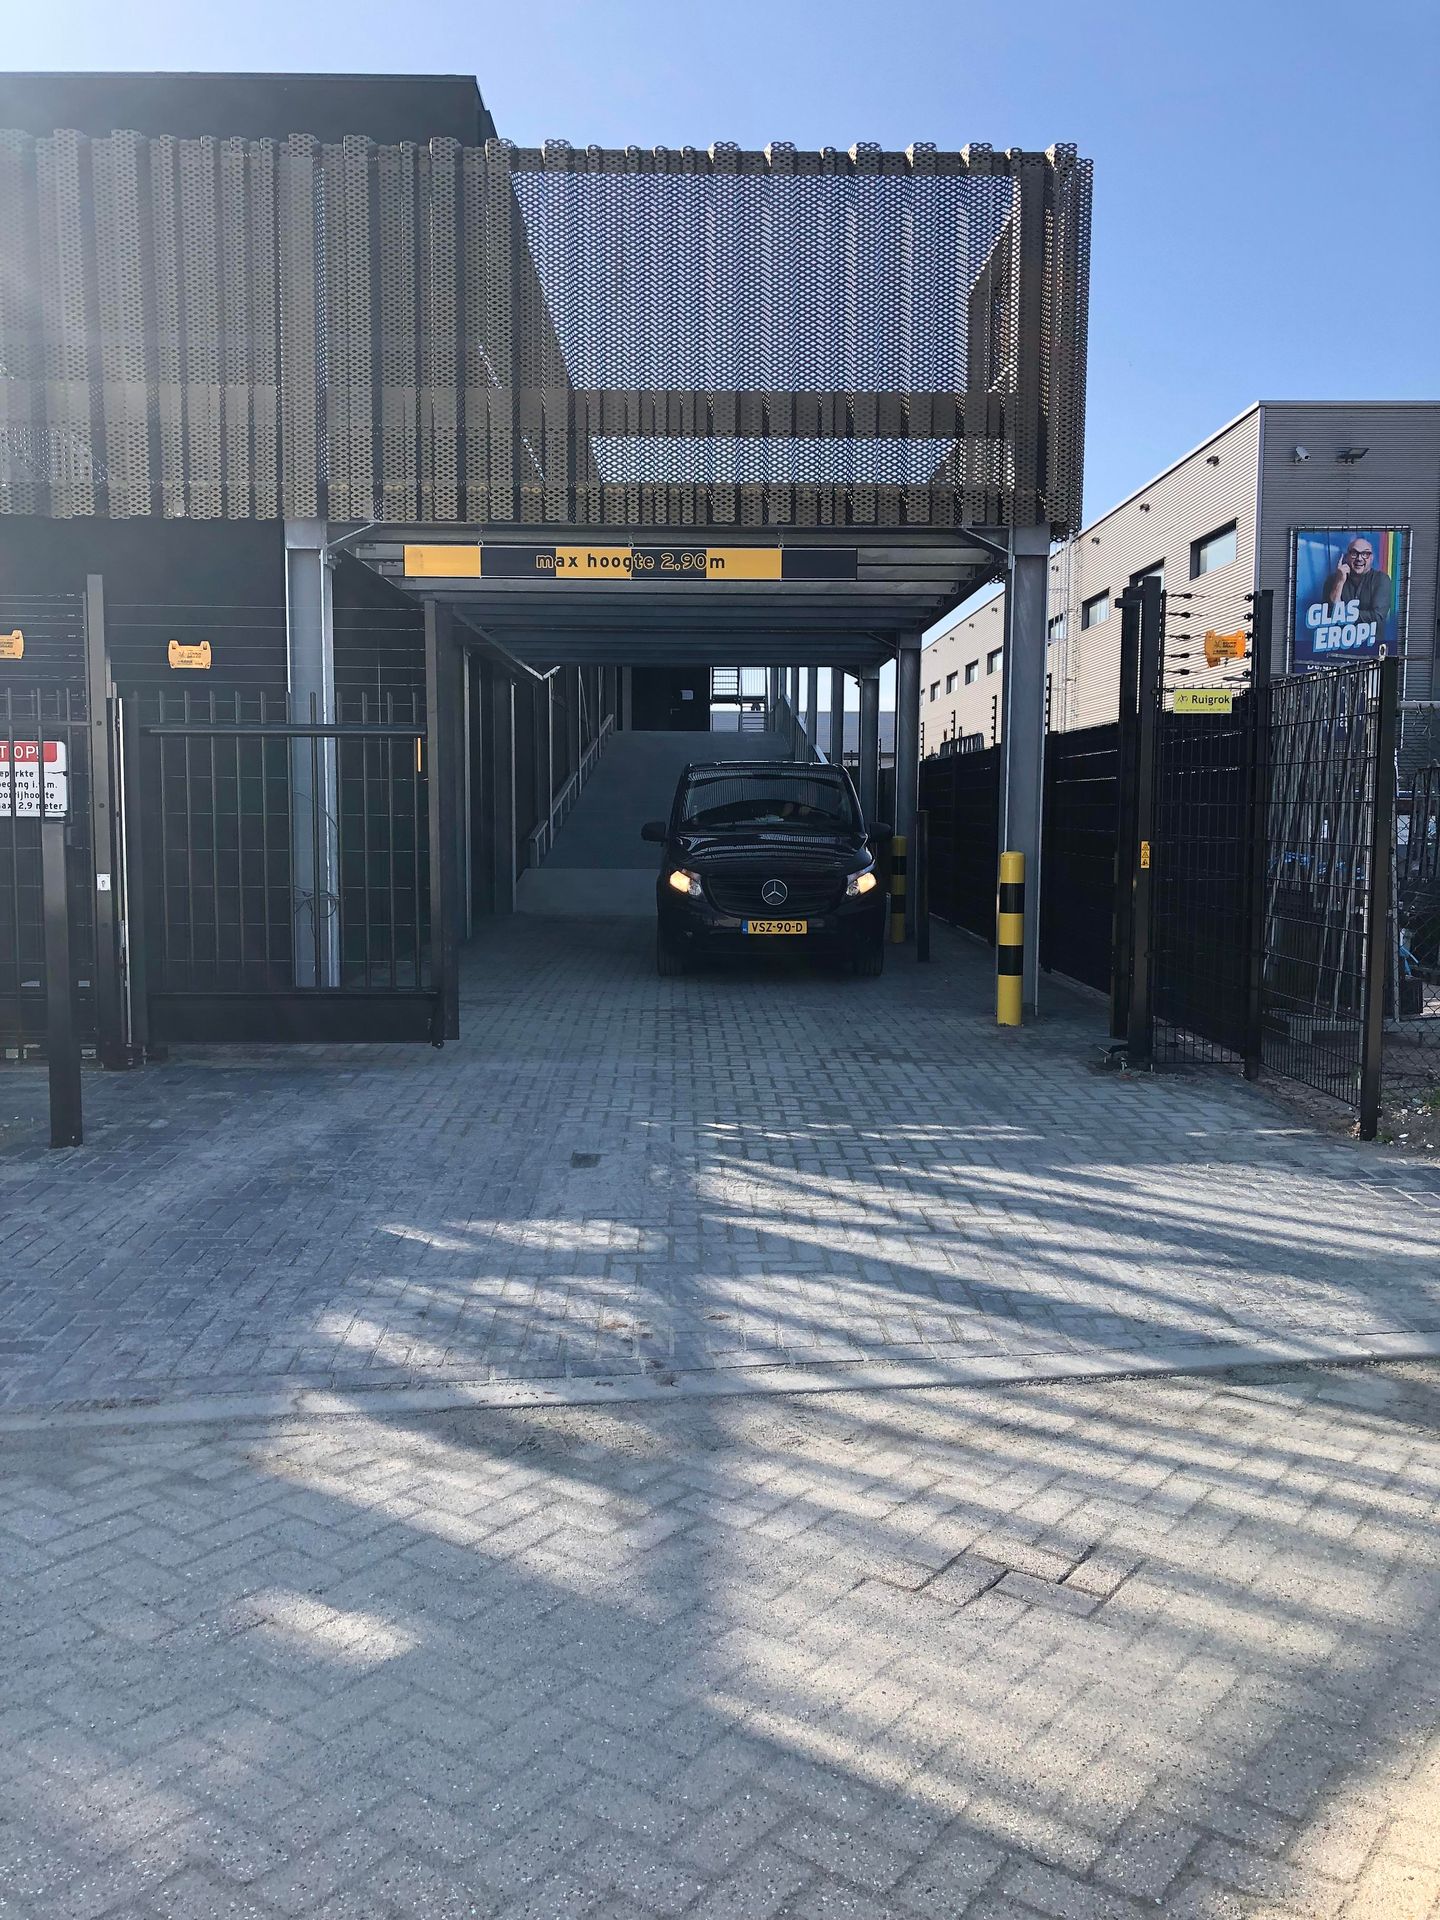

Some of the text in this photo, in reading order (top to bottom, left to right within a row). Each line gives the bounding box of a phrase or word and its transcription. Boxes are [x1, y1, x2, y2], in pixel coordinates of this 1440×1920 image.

[535, 554, 579, 569] max
[587, 553, 655, 573] hoogte
[1306, 599, 1361, 629] GLAS
[1313, 621, 1378, 653] EROP!
[1191, 694, 1230, 706] Ruigrok
[0, 770, 34, 779] eprkte
[32, 780, 58, 789] i..m.
[0, 802, 12, 810] ax
[18, 801, 33, 810] 2.9
[751, 922, 803, 933] VSZ-90-D
